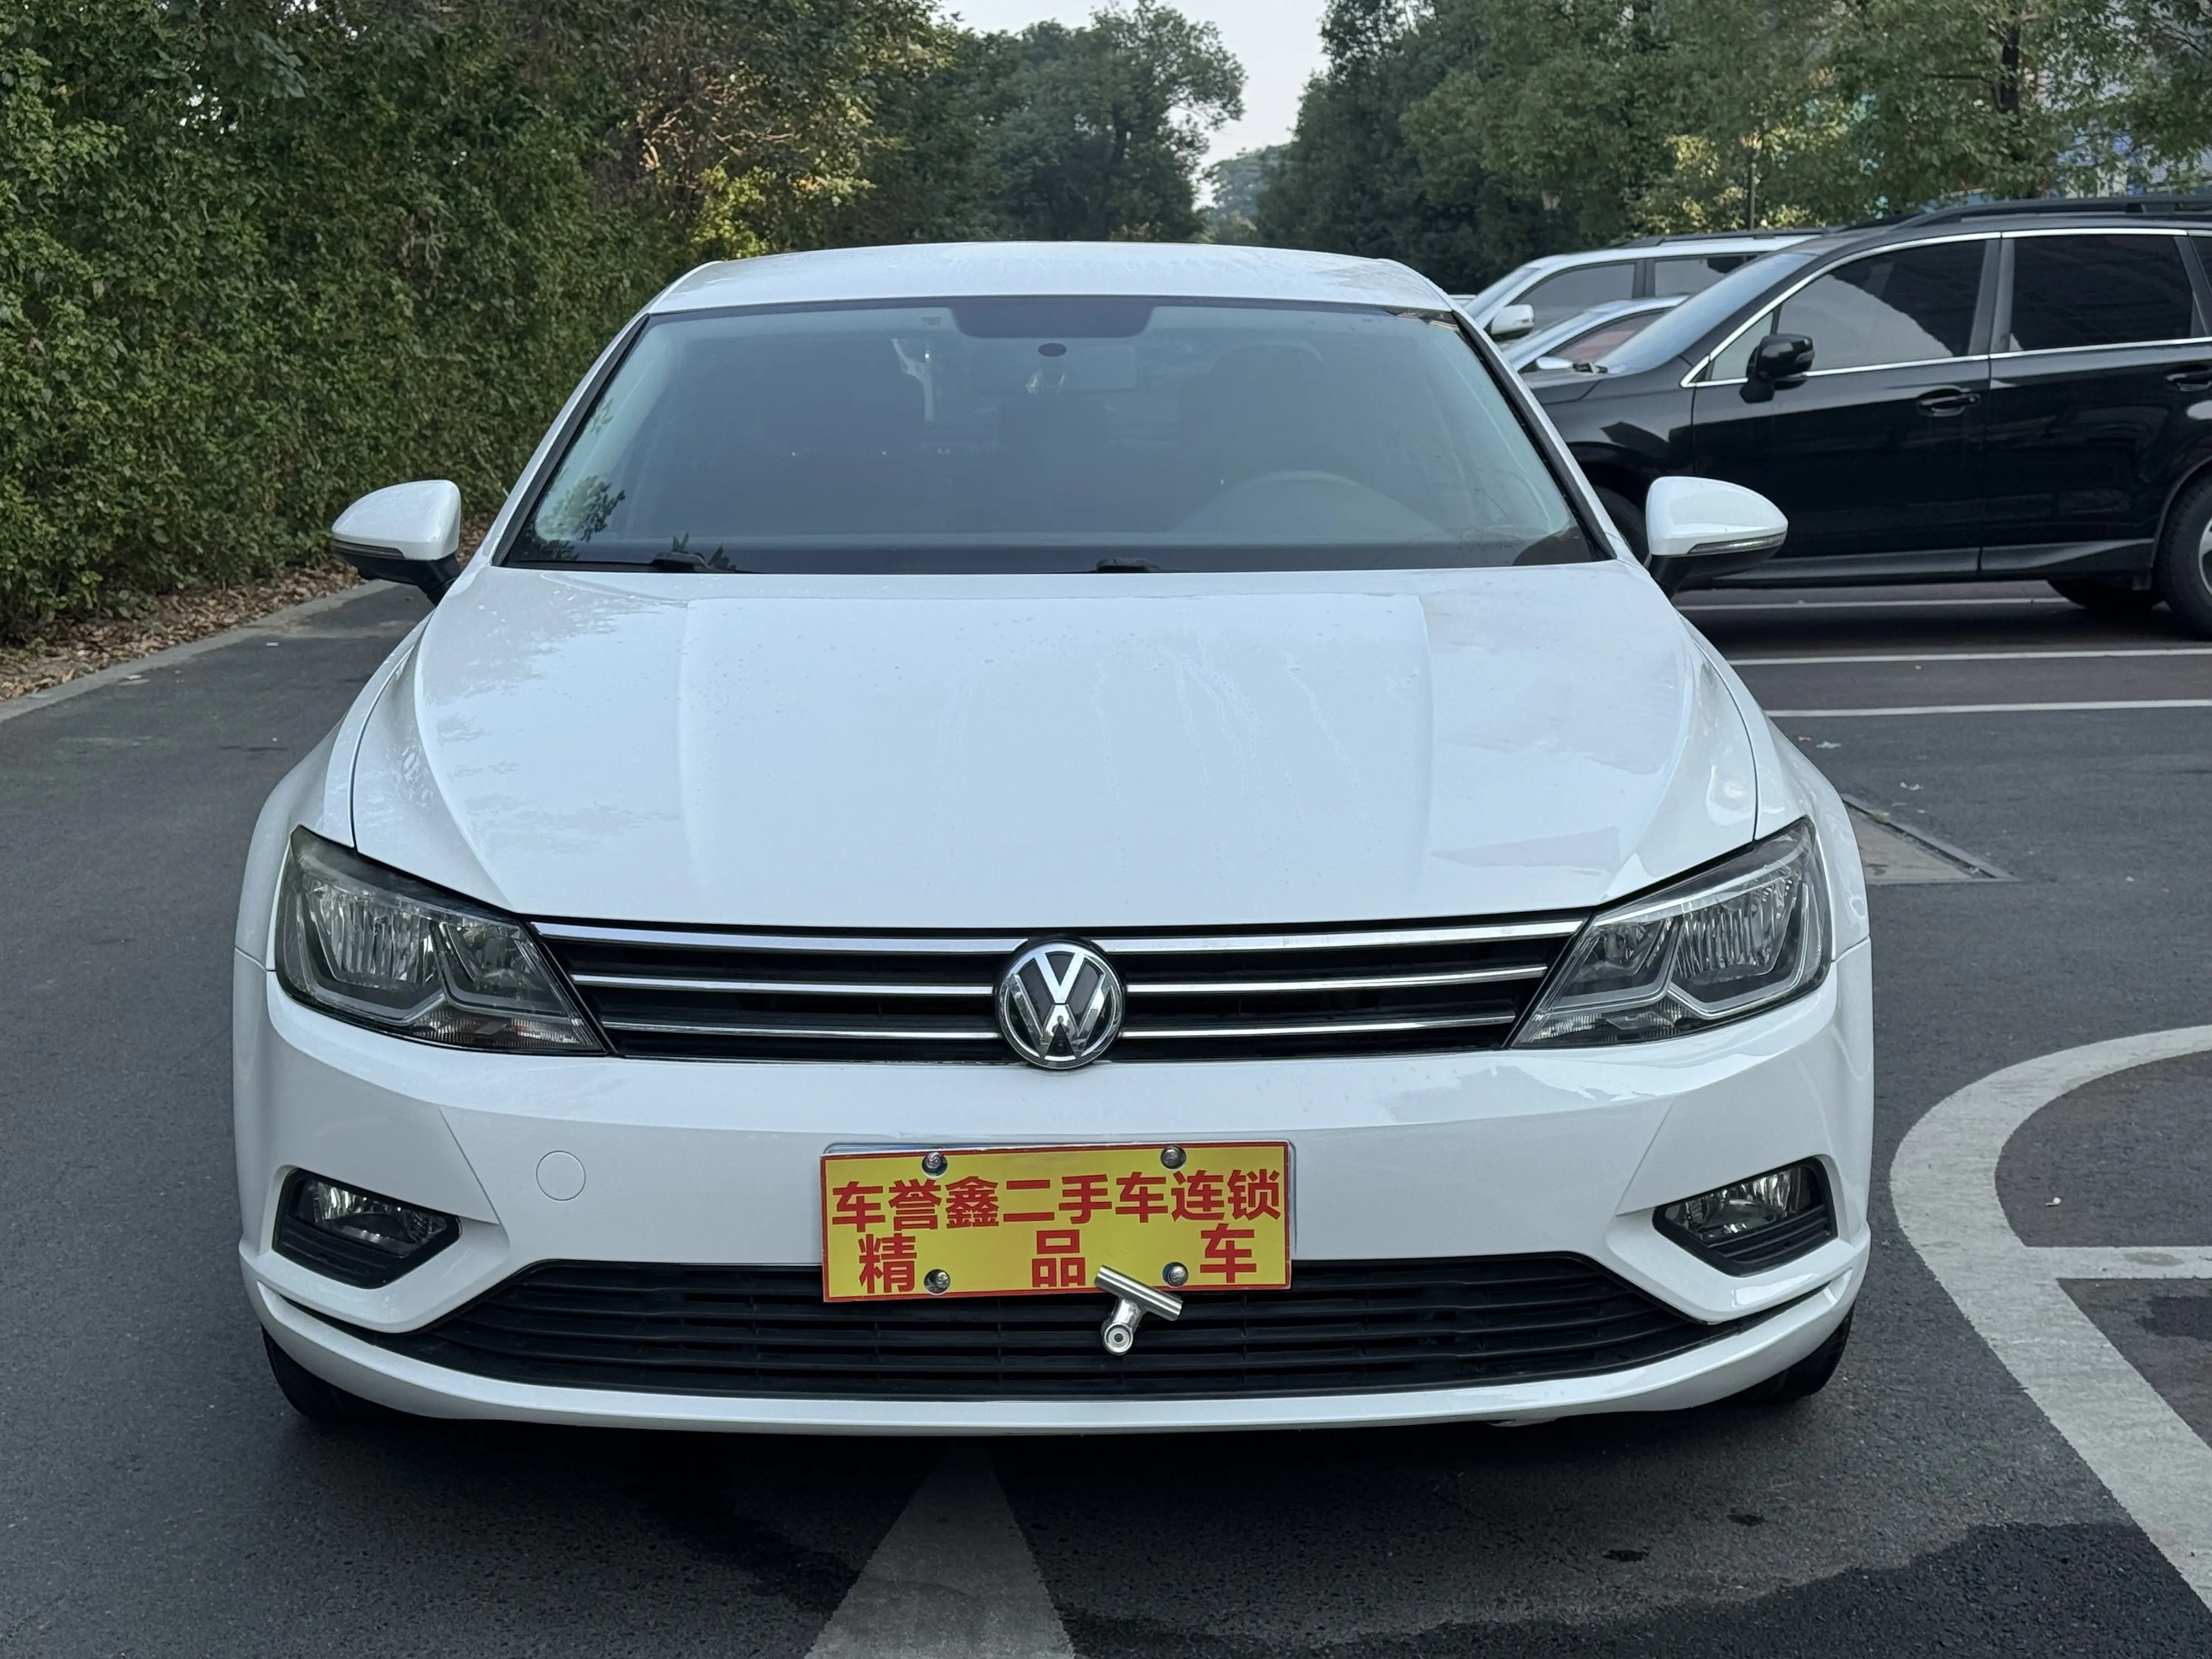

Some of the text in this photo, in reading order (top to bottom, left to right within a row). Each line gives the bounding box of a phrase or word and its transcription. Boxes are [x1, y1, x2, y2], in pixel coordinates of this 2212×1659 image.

[1003, 945, 1120, 1067] VW
[832, 1168, 1280, 1232] 车誉鑫二手车连锁
[859, 1223, 1257, 1294] 精品车
